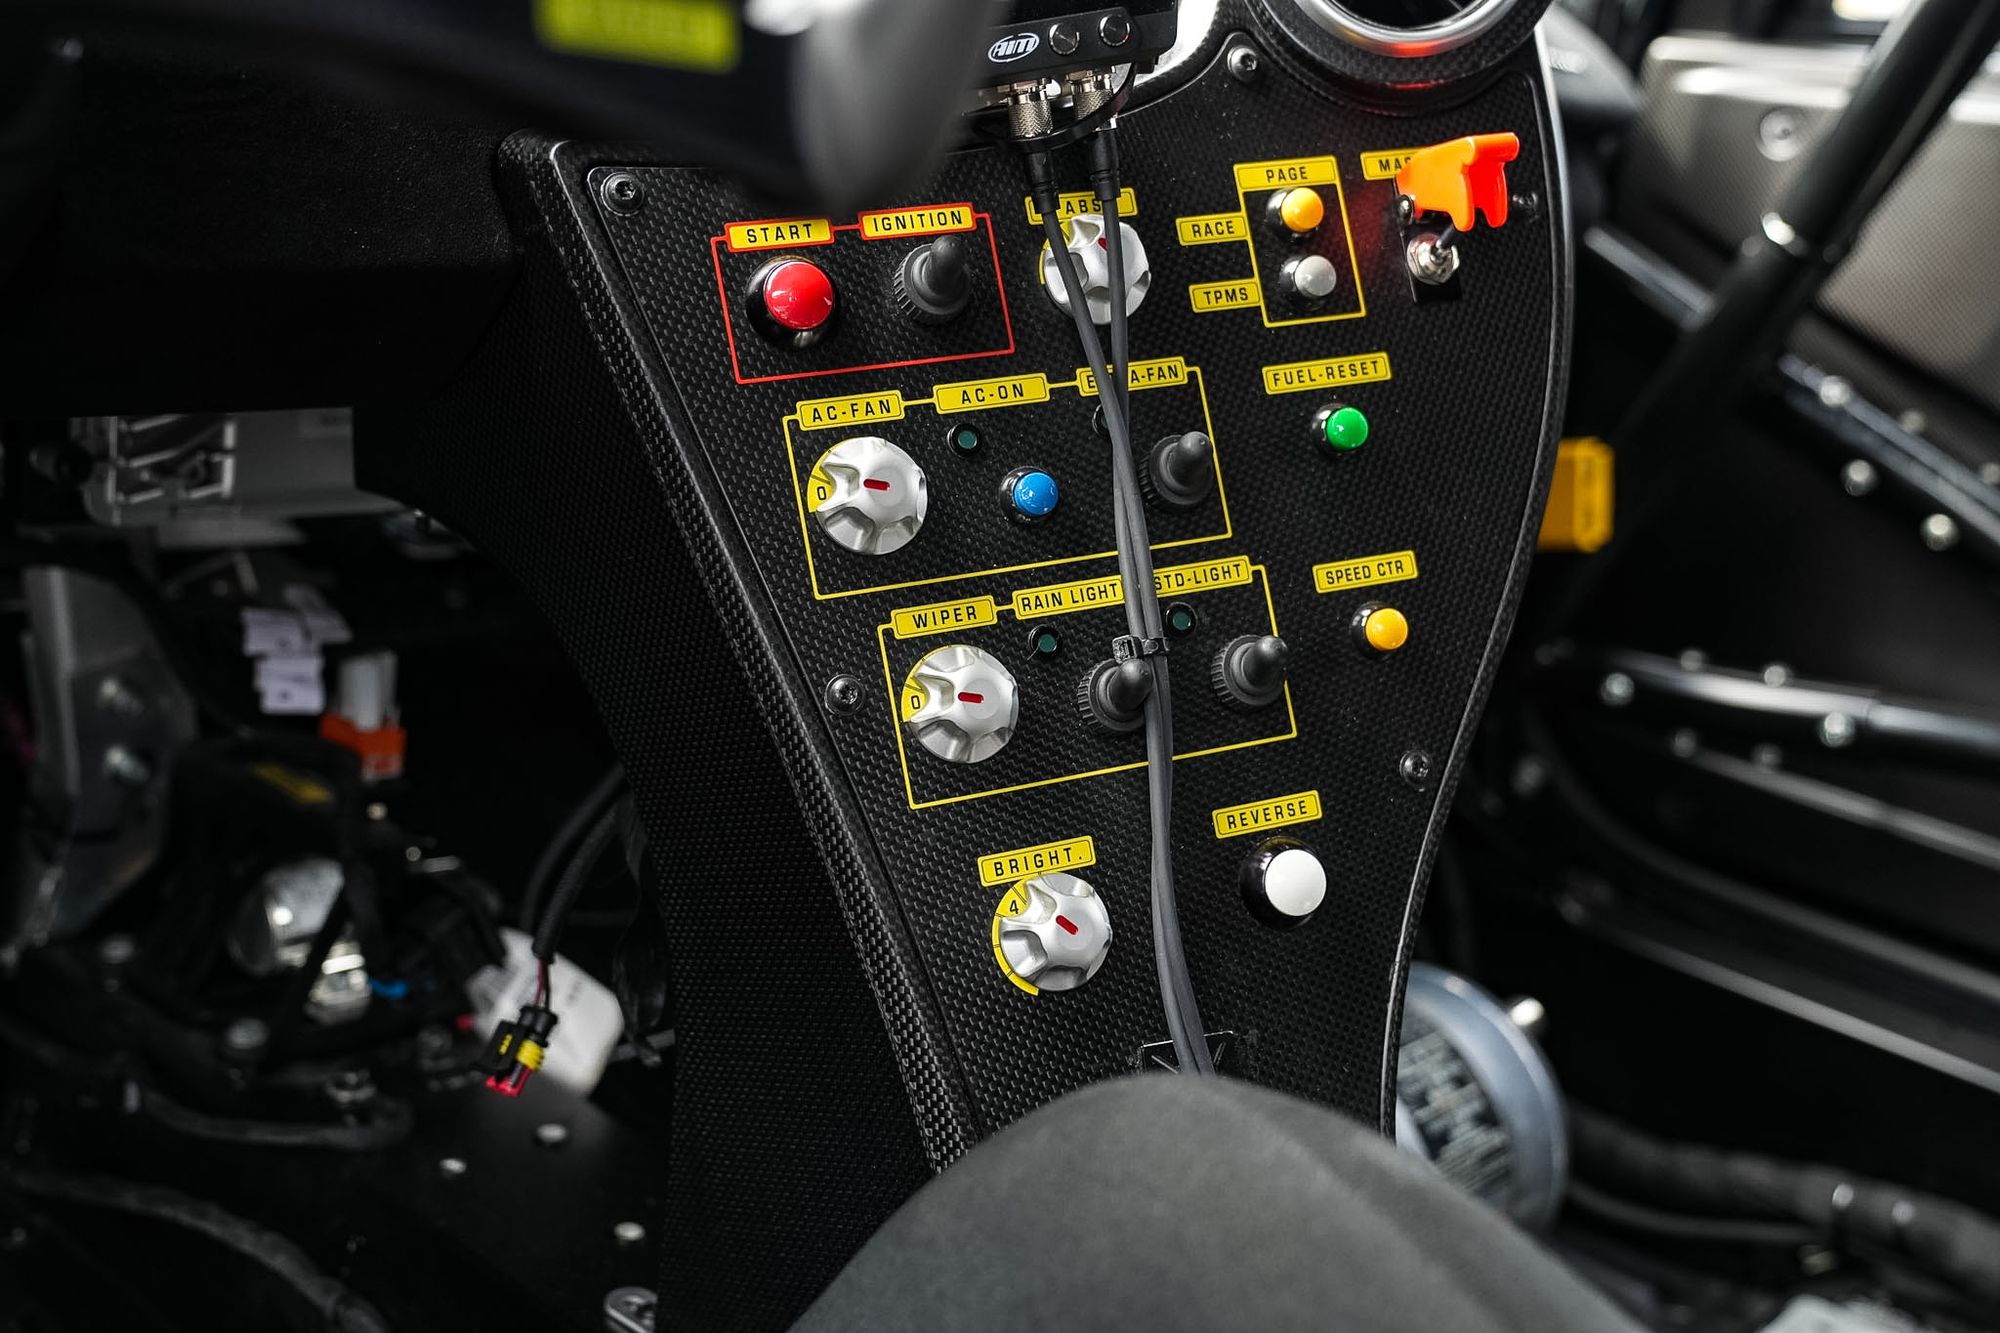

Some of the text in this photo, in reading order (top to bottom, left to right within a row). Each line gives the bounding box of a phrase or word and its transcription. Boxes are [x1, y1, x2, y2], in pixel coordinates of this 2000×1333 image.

[1266, 166, 1308, 183] PAGE
[1065, 199, 1102, 215] ABS
[872, 209, 964, 233] IGNITION
[1191, 220, 1235, 238] RACE
[746, 222, 813, 245] START
[1203, 287, 1249, 305] TPMS
[1086, 364, 1179, 389] EA-FAN
[1272, 359, 1380, 388] FUEL-RESET
[960, 381, 1025, 405] AC-ON
[811, 400, 893, 424] AC-FAN
[1154, 563, 1243, 591] STD-LIGHT
[1325, 559, 1405, 586] SPEED CTR
[1021, 583, 1119, 612] RAIN LIGHT
[912, 604, 979, 630] WIPER
[1226, 800, 1309, 830] REVERSE
[993, 847, 1085, 878] BRIGHT.
[1008, 899, 1020, 915] 4
